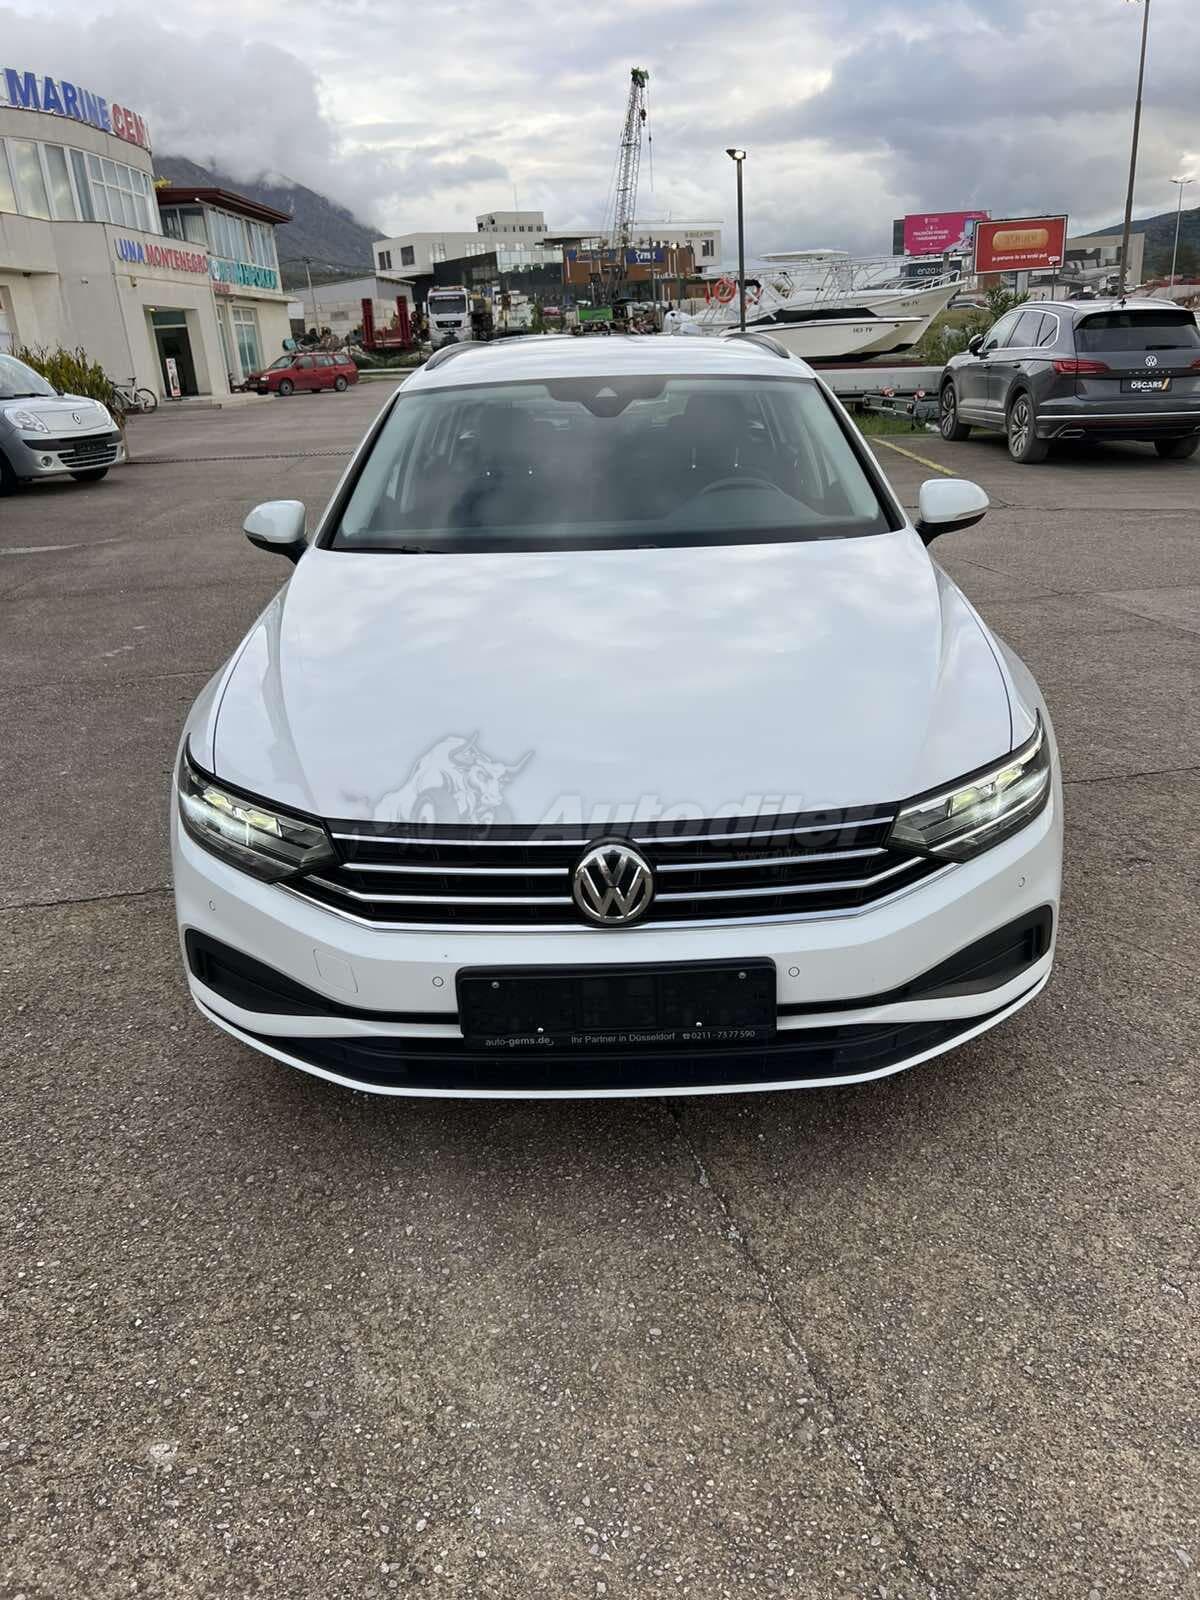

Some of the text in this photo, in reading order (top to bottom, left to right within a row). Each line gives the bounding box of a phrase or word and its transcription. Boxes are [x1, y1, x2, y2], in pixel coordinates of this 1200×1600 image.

[4, 67, 151, 150] MARINE CEN
[144, 243, 209, 273] MONTENEGRO
[485, 1036, 551, 1048] auto-gems.de
[584, 1035, 616, 1044] Partner
